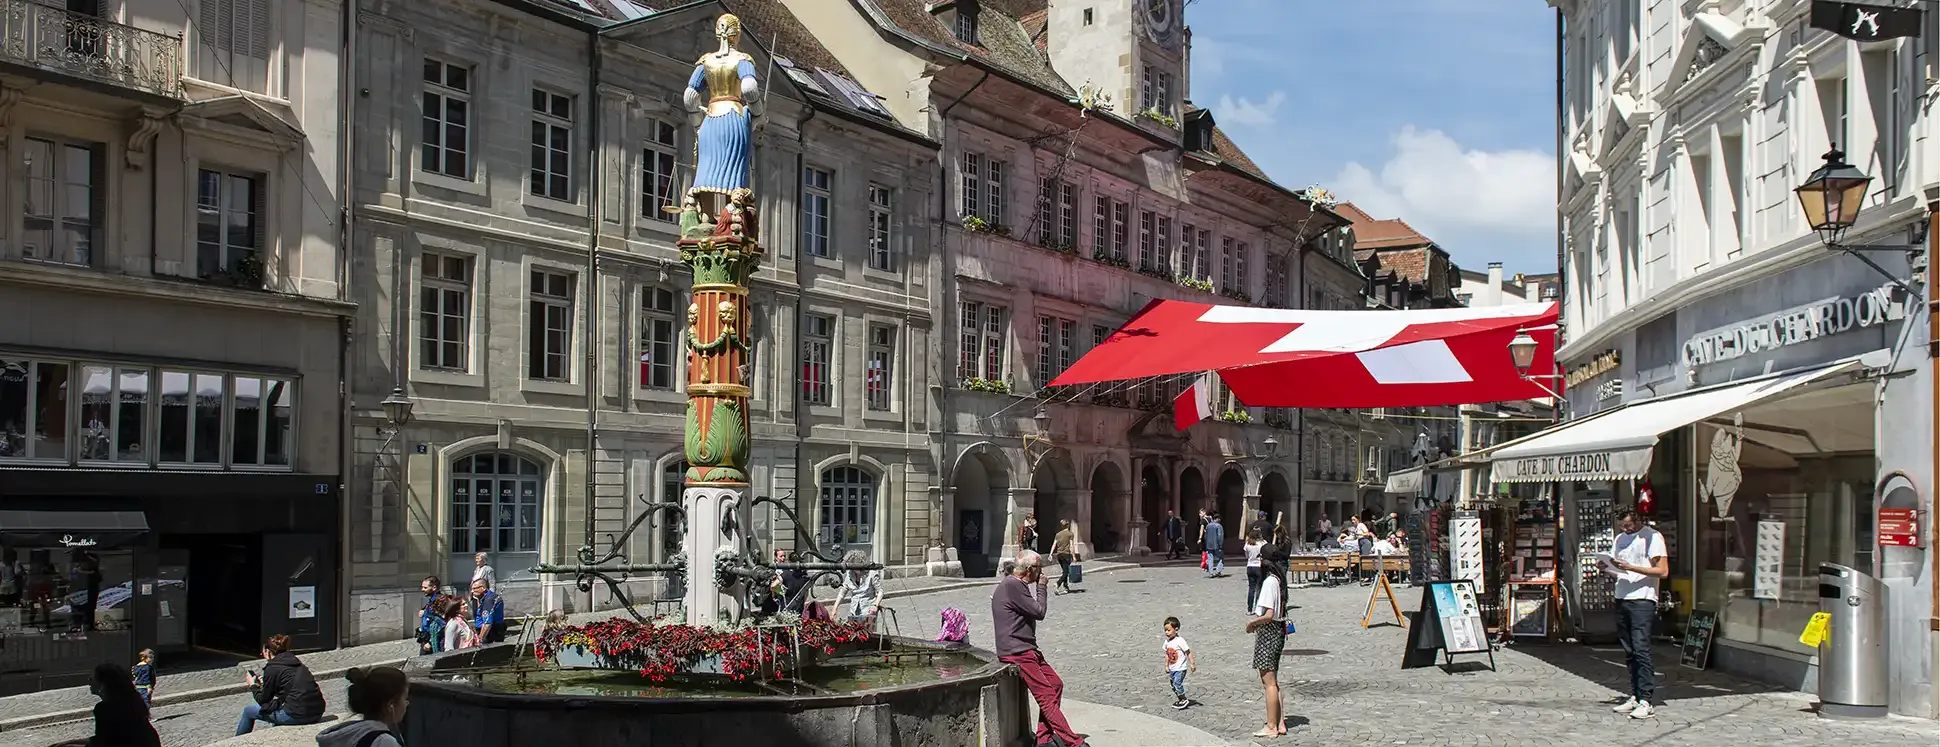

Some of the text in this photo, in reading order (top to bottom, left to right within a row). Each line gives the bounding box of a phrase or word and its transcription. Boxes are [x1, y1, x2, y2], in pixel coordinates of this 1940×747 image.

[1682, 286, 1895, 367] CAVE DU CHARDON
[1516, 453, 1611, 475] CAVE DU CHARDON
[58, 533, 97, 547] Pomellato
